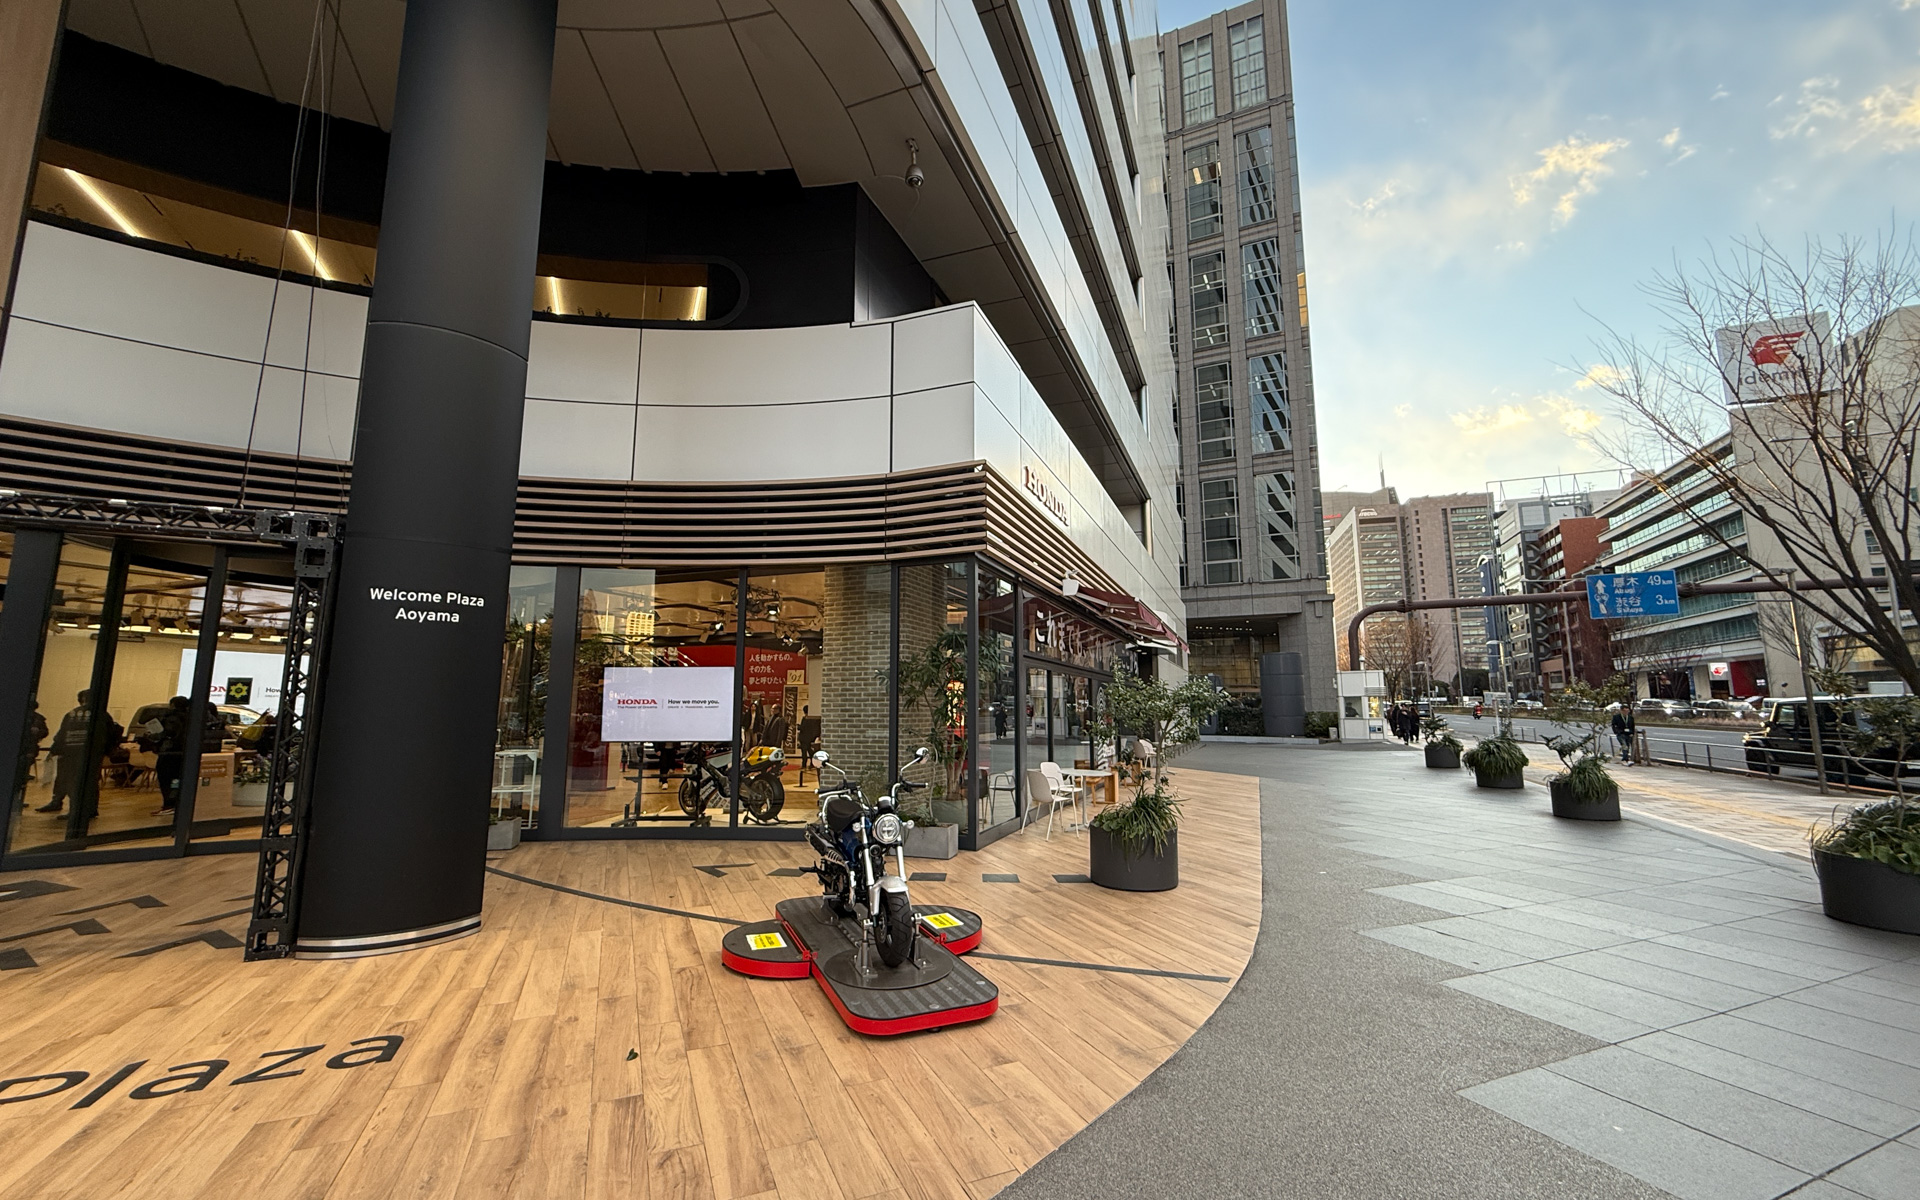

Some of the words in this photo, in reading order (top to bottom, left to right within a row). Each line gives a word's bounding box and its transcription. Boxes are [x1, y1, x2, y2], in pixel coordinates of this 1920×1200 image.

[1024, 466, 1069, 527] HONDA
[370, 588, 442, 603] Welcome
[446, 592, 485, 607] Plaza
[395, 608, 460, 623] Aoyama
